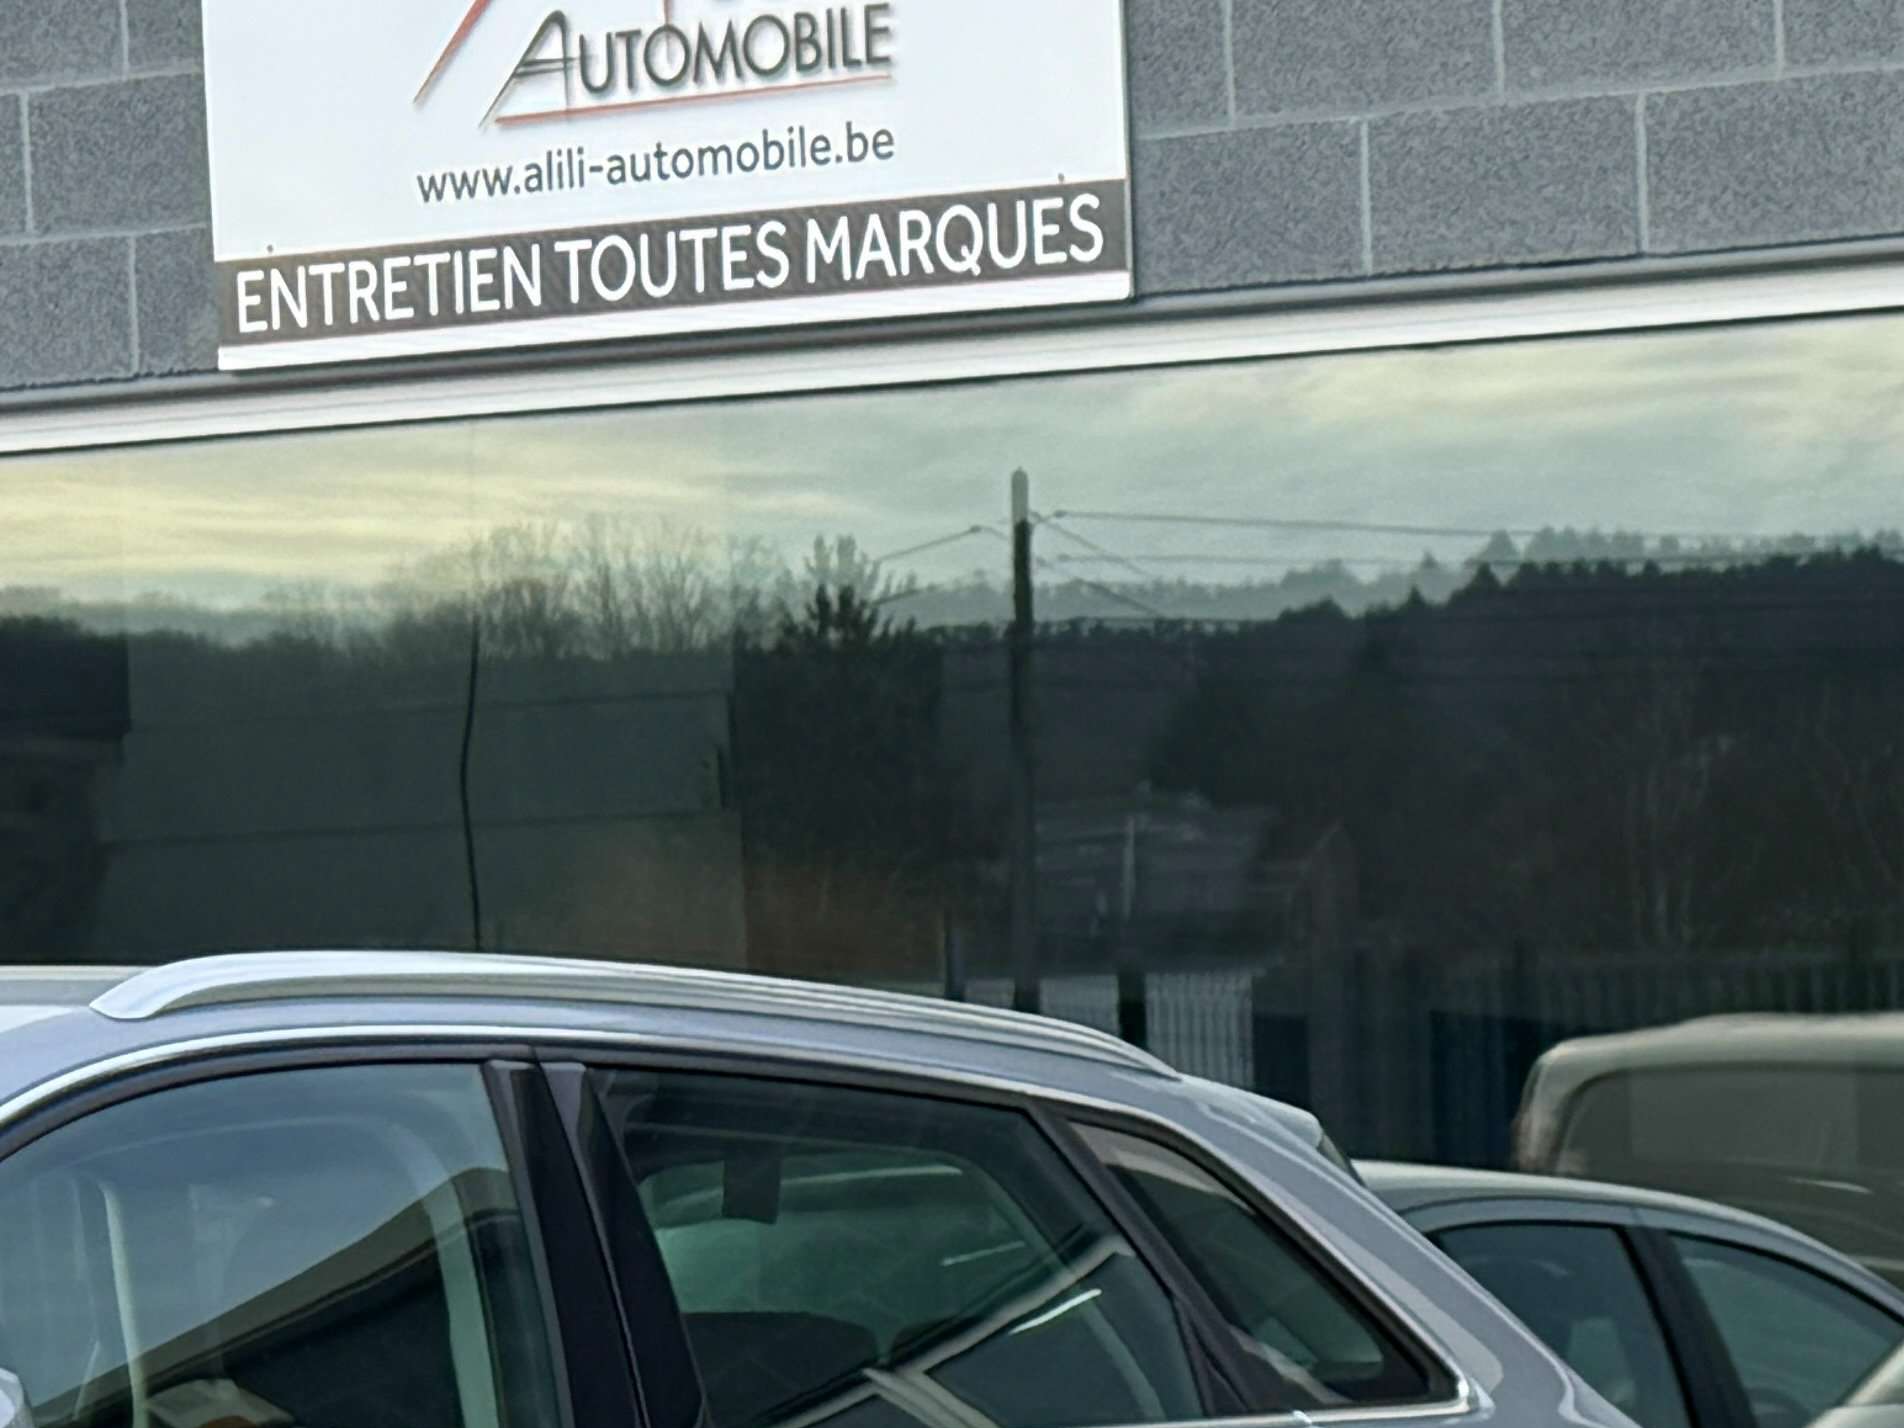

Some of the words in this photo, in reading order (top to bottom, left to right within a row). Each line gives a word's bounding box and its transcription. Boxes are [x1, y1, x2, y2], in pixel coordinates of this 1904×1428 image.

[479, 3, 891, 130] AUTOMOBILE
[417, 120, 895, 204] www.alili-automobile.be
[236, 243, 542, 333] ENTRETIEN
[553, 219, 790, 304] TOUTES
[805, 193, 1104, 284] MARQUES
